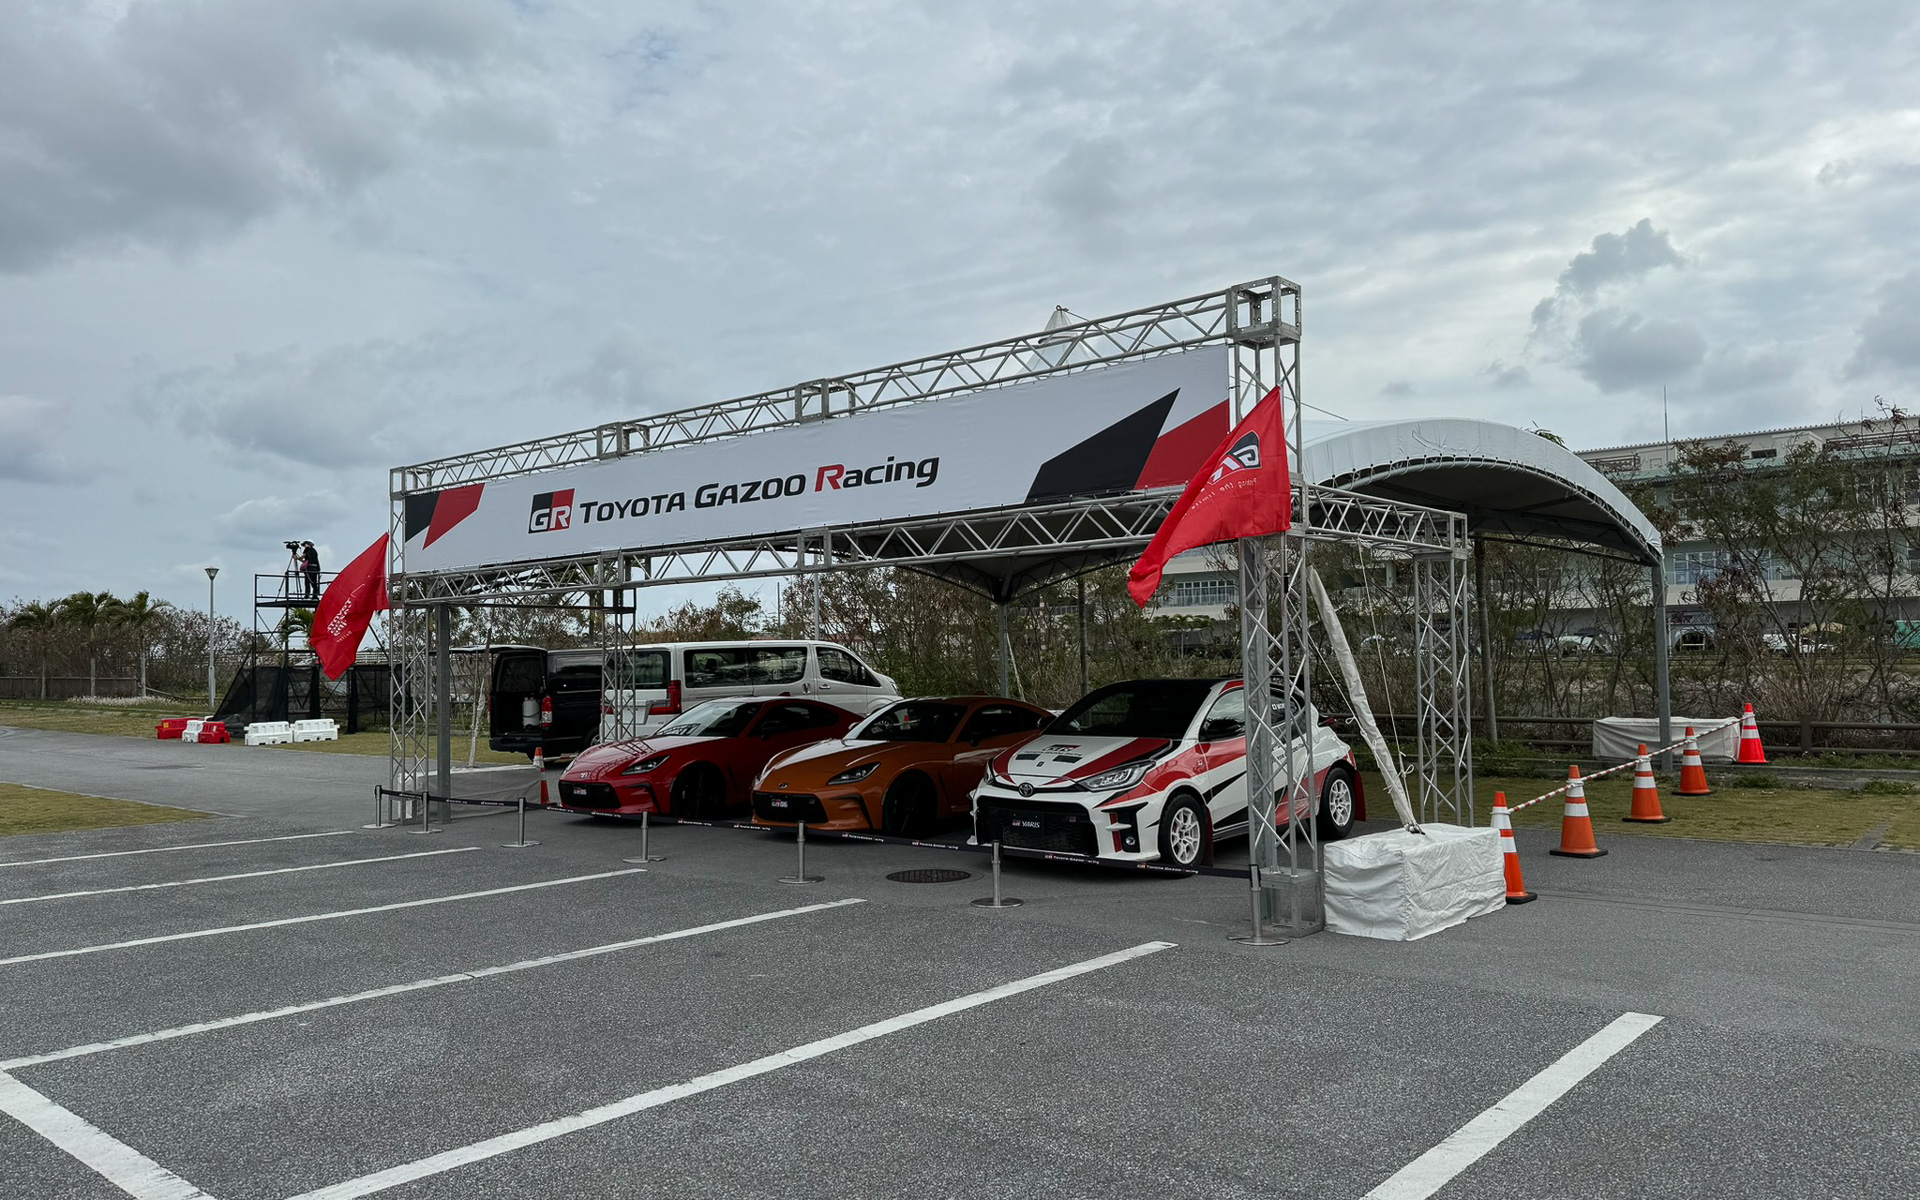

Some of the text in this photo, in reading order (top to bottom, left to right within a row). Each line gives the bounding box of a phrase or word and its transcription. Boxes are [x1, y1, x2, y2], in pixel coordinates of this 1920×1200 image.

[529, 456, 940, 532] GR TOYOTA GAZOO Racing
